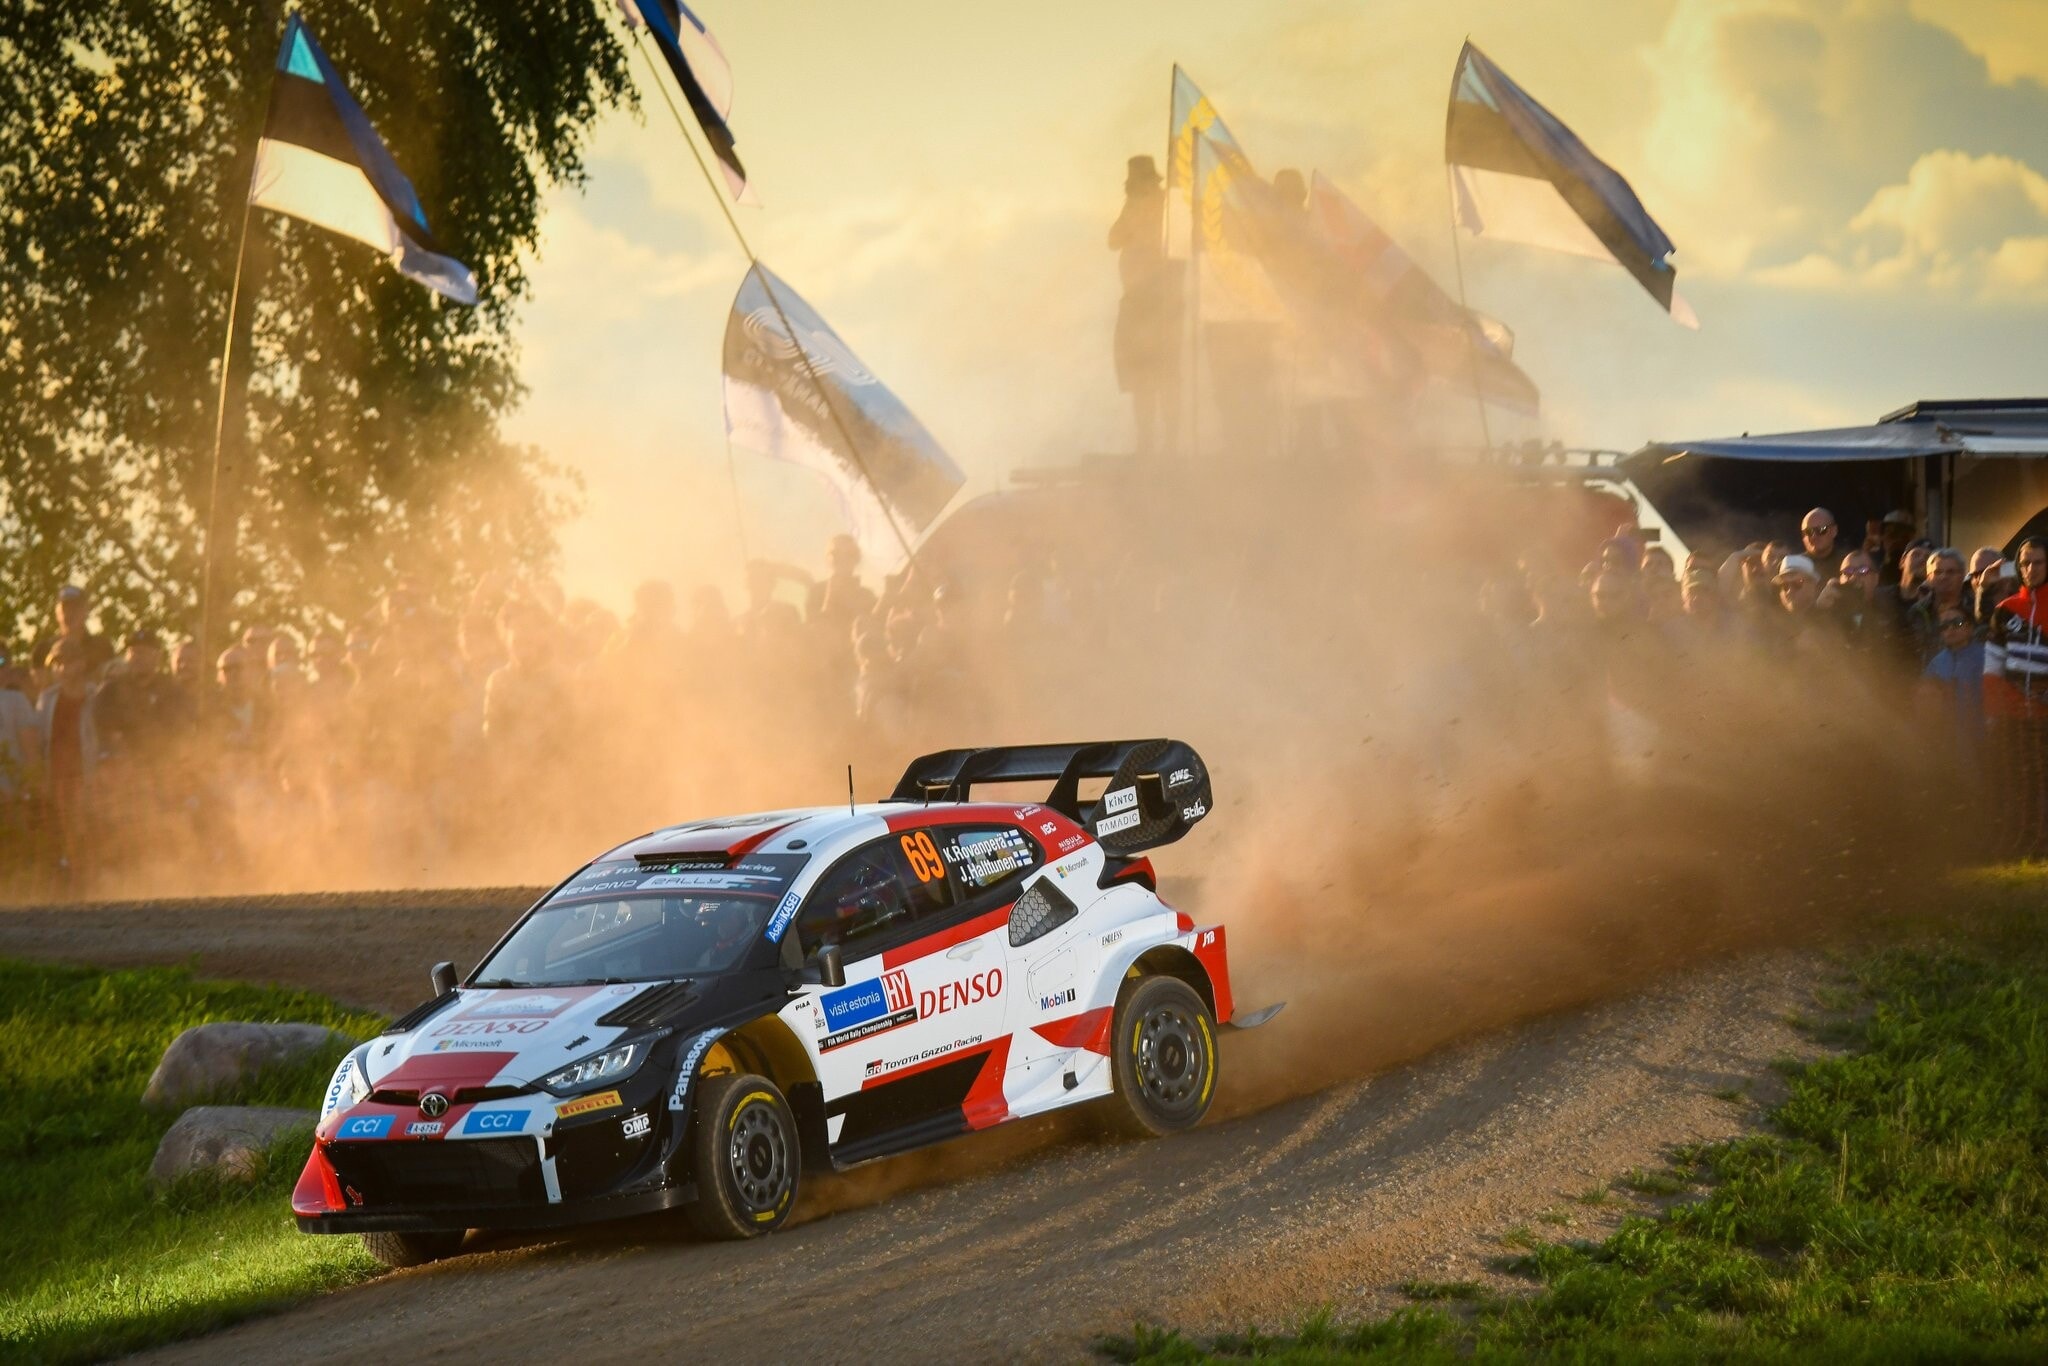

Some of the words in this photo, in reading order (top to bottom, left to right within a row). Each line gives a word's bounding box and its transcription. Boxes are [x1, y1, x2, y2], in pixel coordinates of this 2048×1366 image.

[900, 831, 945, 883] 69
[829, 1002, 849, 1017] visit
[849, 992, 881, 1011] estonia
[920, 968, 1003, 1020] DENSO
[1041, 991, 1066, 1010] Mobil
[1067, 989, 1075, 1002] 1
[430, 1020, 550, 1037] DENSO
[452, 1040, 503, 1048] Microsoft
[884, 1054, 919, 1070] TOYOTA
[921, 1043, 952, 1059] GAZOO
[954, 1034, 982, 1049] Racing
[561, 1093, 617, 1116] PIRELLI
[623, 1116, 650, 1135] OMP
